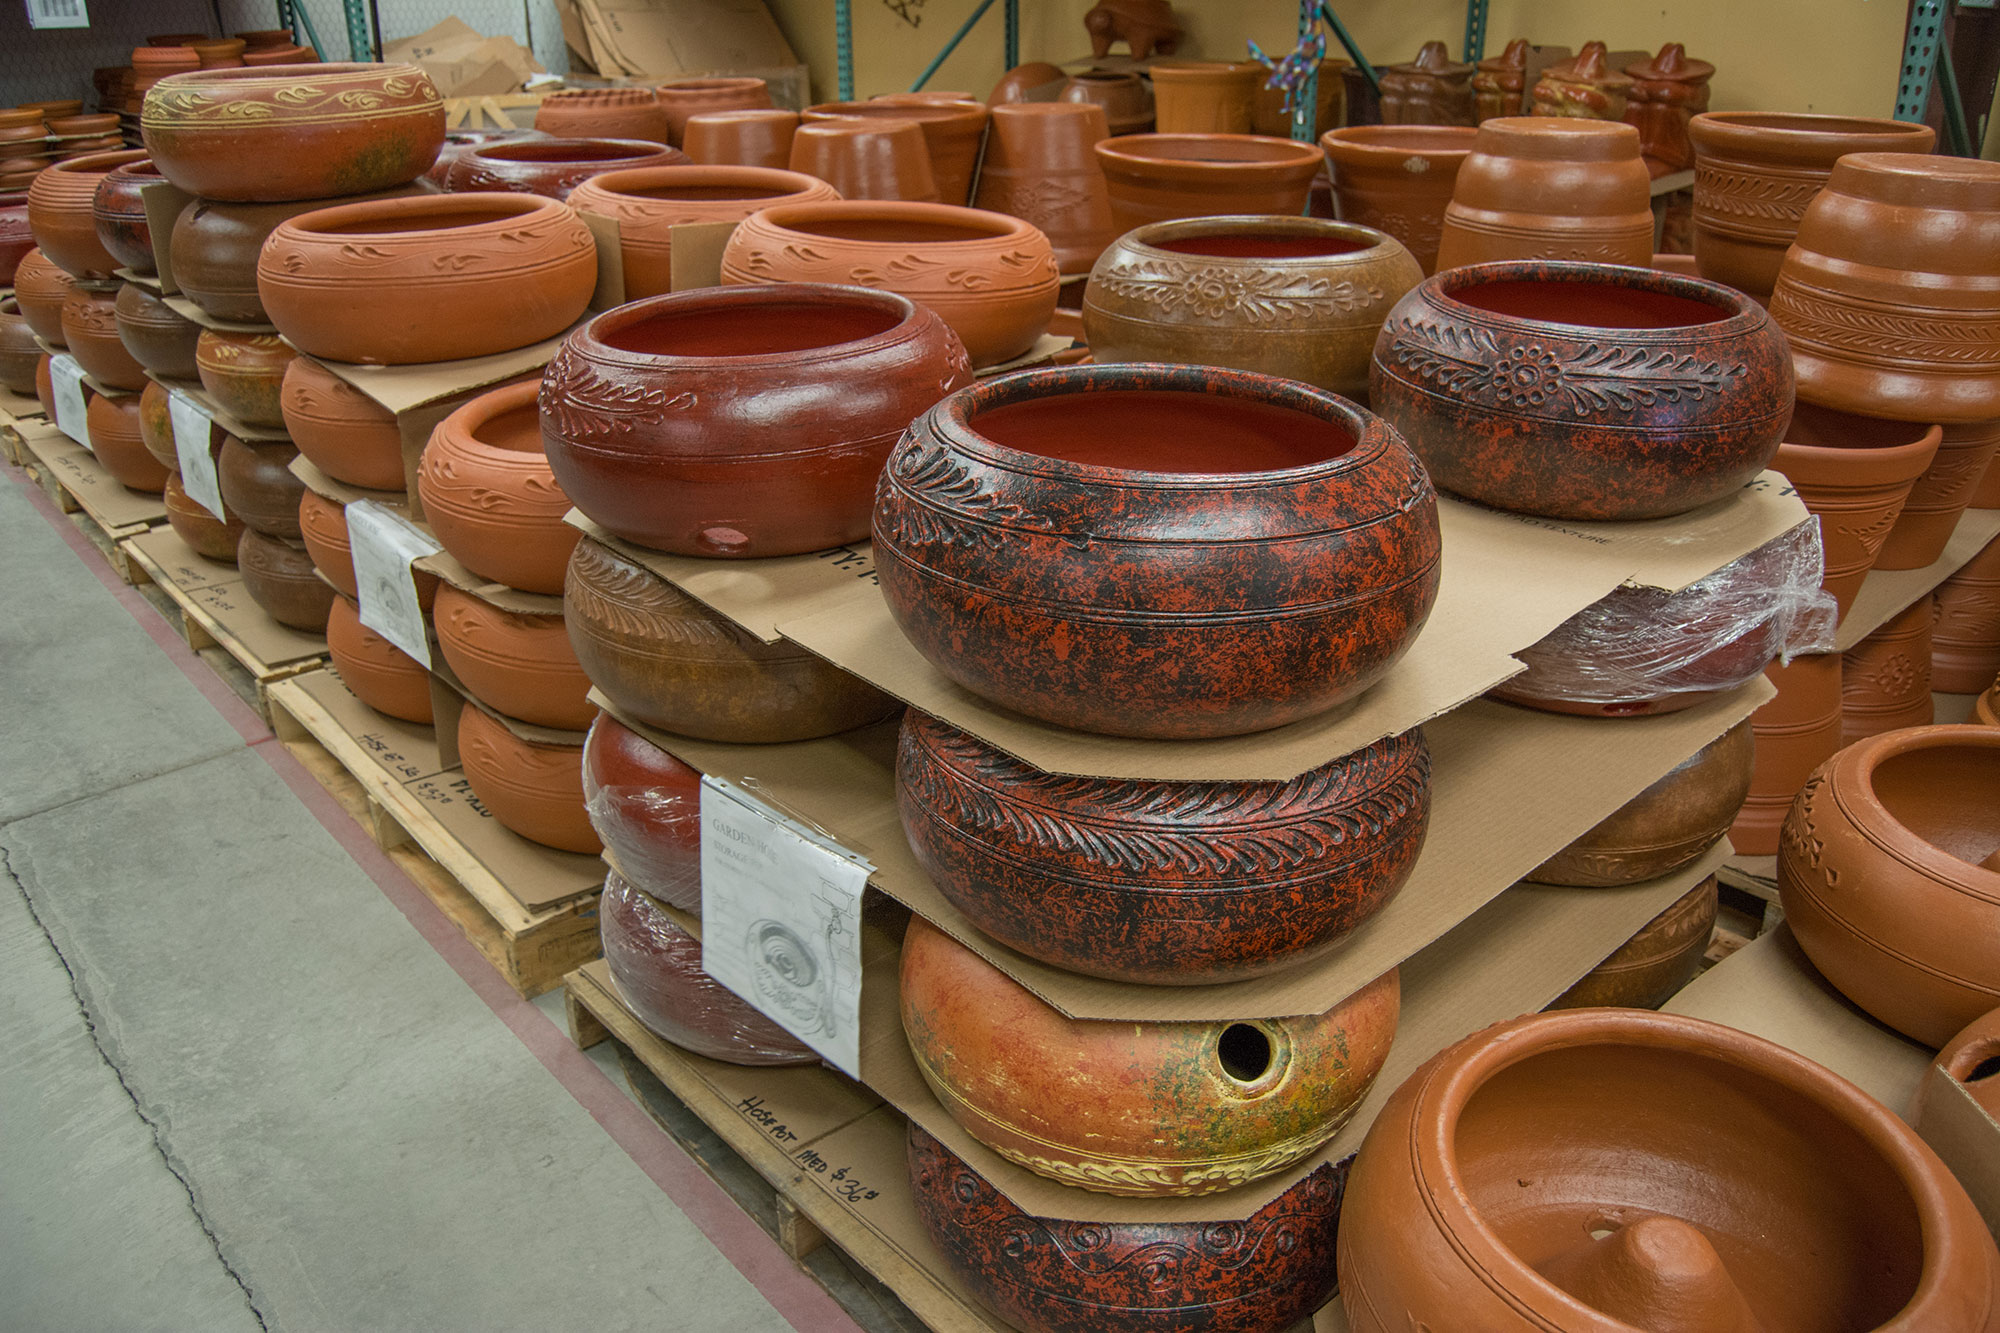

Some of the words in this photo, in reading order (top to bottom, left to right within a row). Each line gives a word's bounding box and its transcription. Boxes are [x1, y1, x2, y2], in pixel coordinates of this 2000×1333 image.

[1542, 523, 1612, 545] TEXTURE
[712, 818, 754, 847] GARDEN
[736, 1095, 778, 1126] HOSE
[769, 1124, 798, 1143] POT
[795, 1149, 828, 1174] MED
